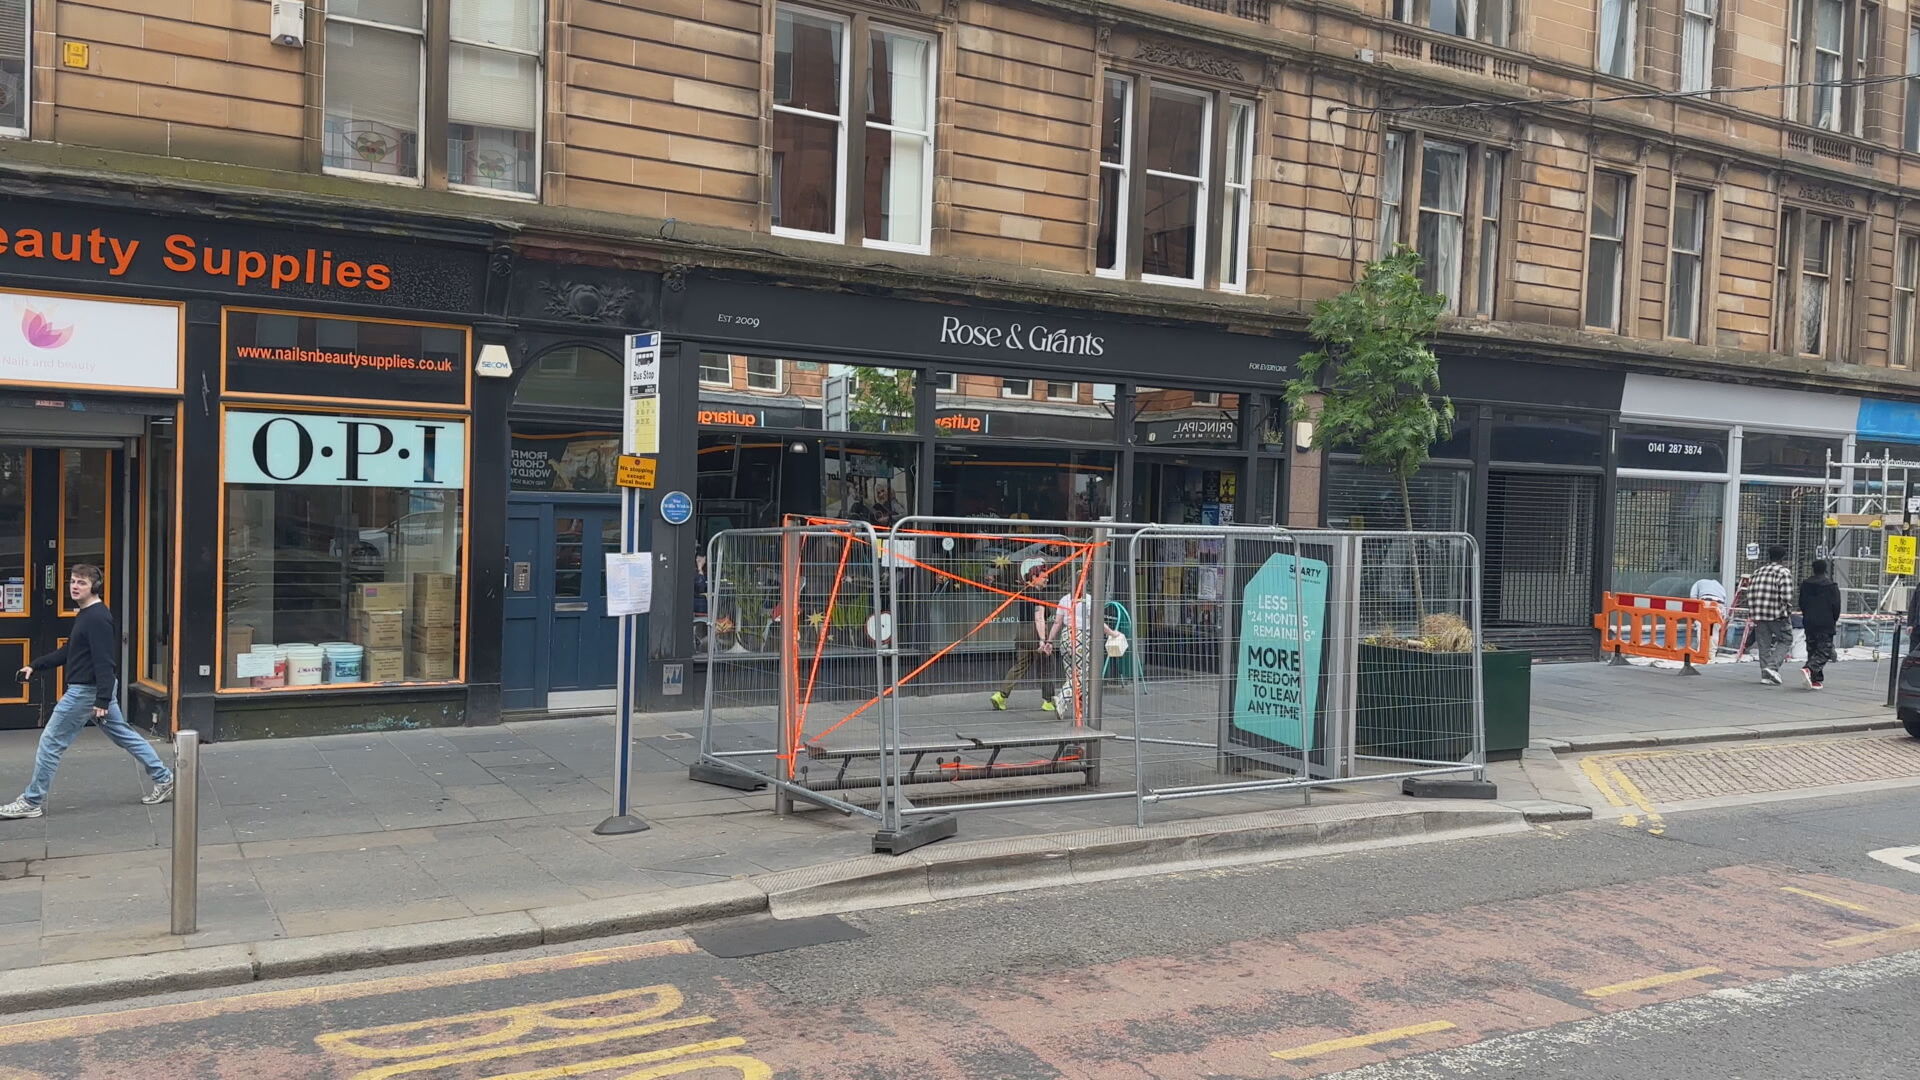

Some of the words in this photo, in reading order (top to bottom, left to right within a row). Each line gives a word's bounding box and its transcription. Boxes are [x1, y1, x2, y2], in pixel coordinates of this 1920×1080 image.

[0, 227, 139, 276] auty
[163, 234, 391, 291] Supplies
[735, 316, 760, 327] 2009
[940, 316, 1001, 346] Rose
[1005, 323, 1024, 350] &
[1028, 324, 1105, 357] Grants
[237, 344, 453, 372] www.nailsnbeautysupplies.co.uk
[481, 361, 508, 369] SECOM
[633, 371, 642, 381] Bus
[643, 370, 654, 380] Stop
[1648, 442, 1665, 453] 0141
[1668, 443, 1683, 454] 287
[1684, 444, 1702, 456] 3874
[1289, 564, 1321, 578] SARTY
[1258, 594, 1288, 611] LESS
[1248, 645, 1300, 673] MORE
[1248, 668, 1301, 689] FREEDOM
[1253, 685, 1267, 699] TO
[1247, 700, 1300, 721] ANYTIME
